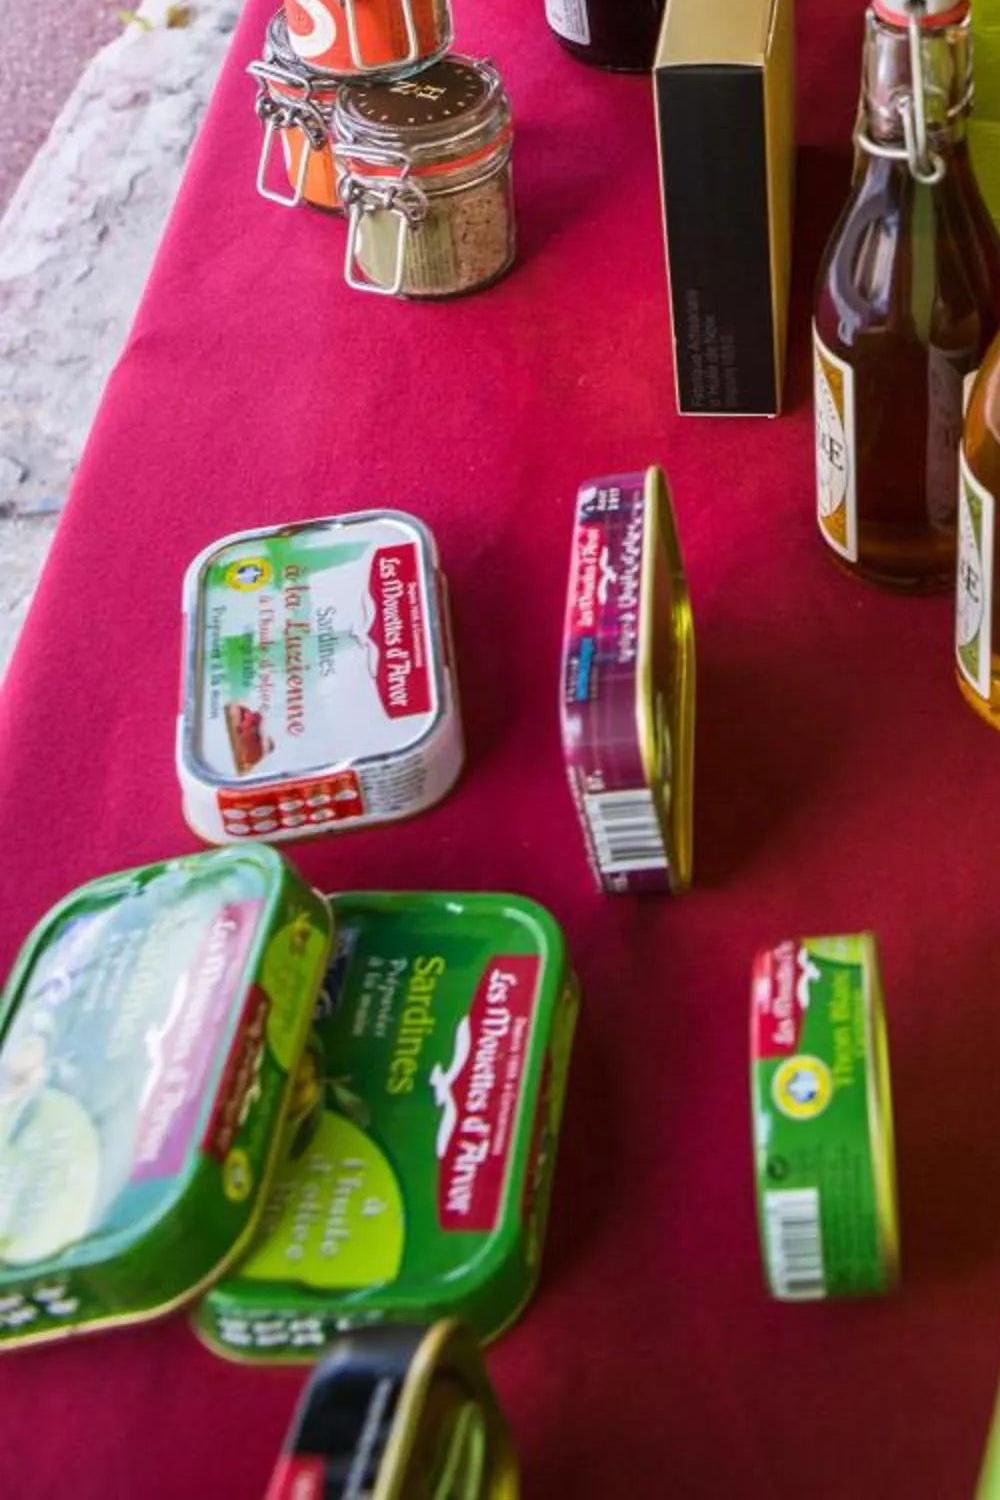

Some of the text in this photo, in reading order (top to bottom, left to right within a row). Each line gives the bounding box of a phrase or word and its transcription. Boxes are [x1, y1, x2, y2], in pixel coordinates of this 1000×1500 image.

[380, 557, 401, 579] Les
[283, 564, 311, 737] à la Luzienne
[316, 606, 337, 678] Sardines
[381, 580, 404, 646] Mouettes
[386, 955, 445, 1096] Sardines
[486, 969, 517, 1004] Les
[466, 1006, 512, 1125] Mouettes
[448, 1119, 492, 1214] d'Arvor
